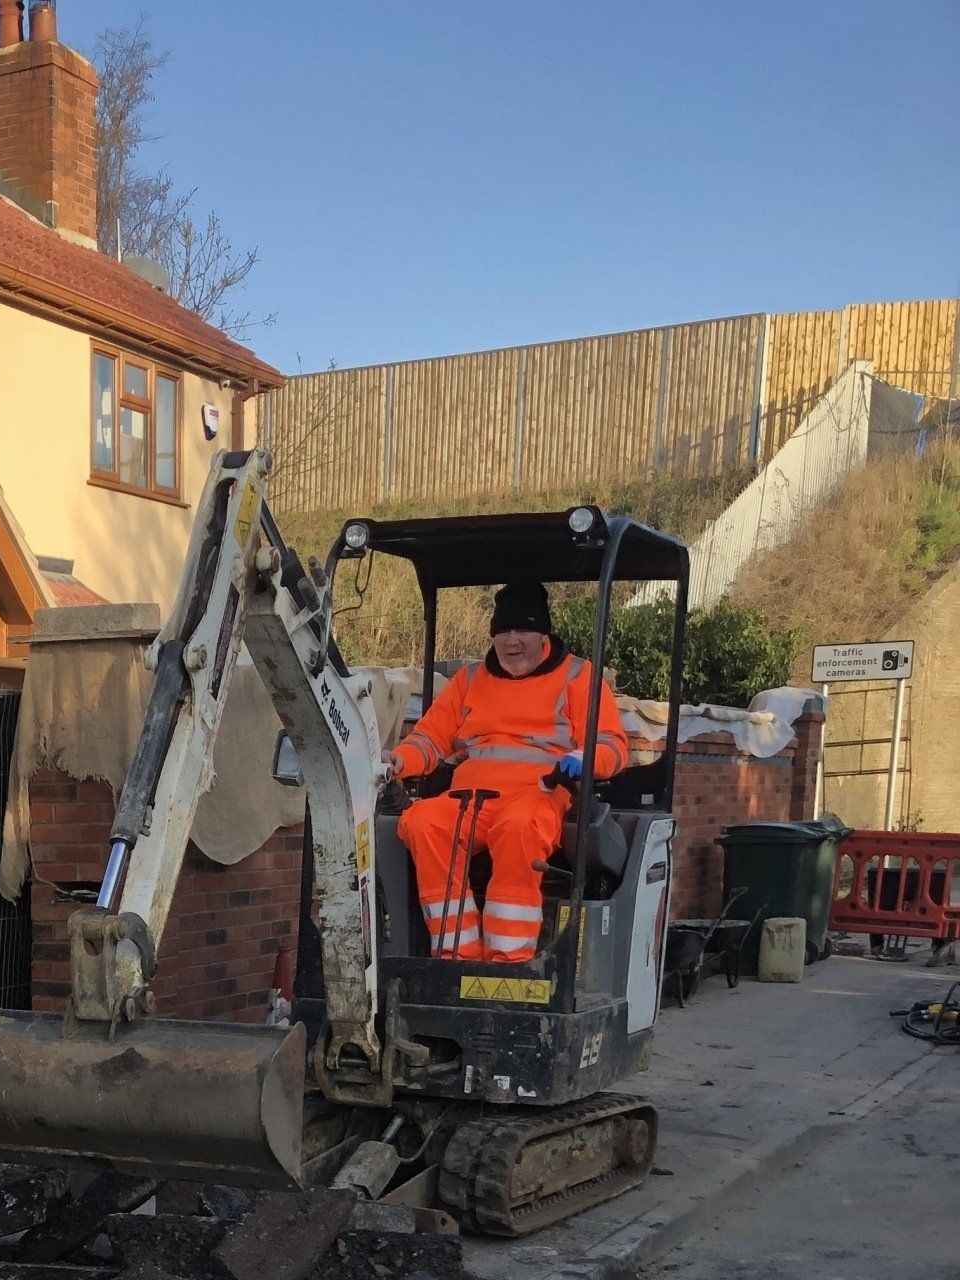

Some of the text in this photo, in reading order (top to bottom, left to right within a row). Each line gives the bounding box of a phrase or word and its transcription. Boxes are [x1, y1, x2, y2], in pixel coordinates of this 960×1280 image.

[832, 648, 864, 657] Traffic
[816, 657, 878, 667] enforcement
[826, 668, 866, 677] cameras
[328, 697, 350, 747] Bobcat
